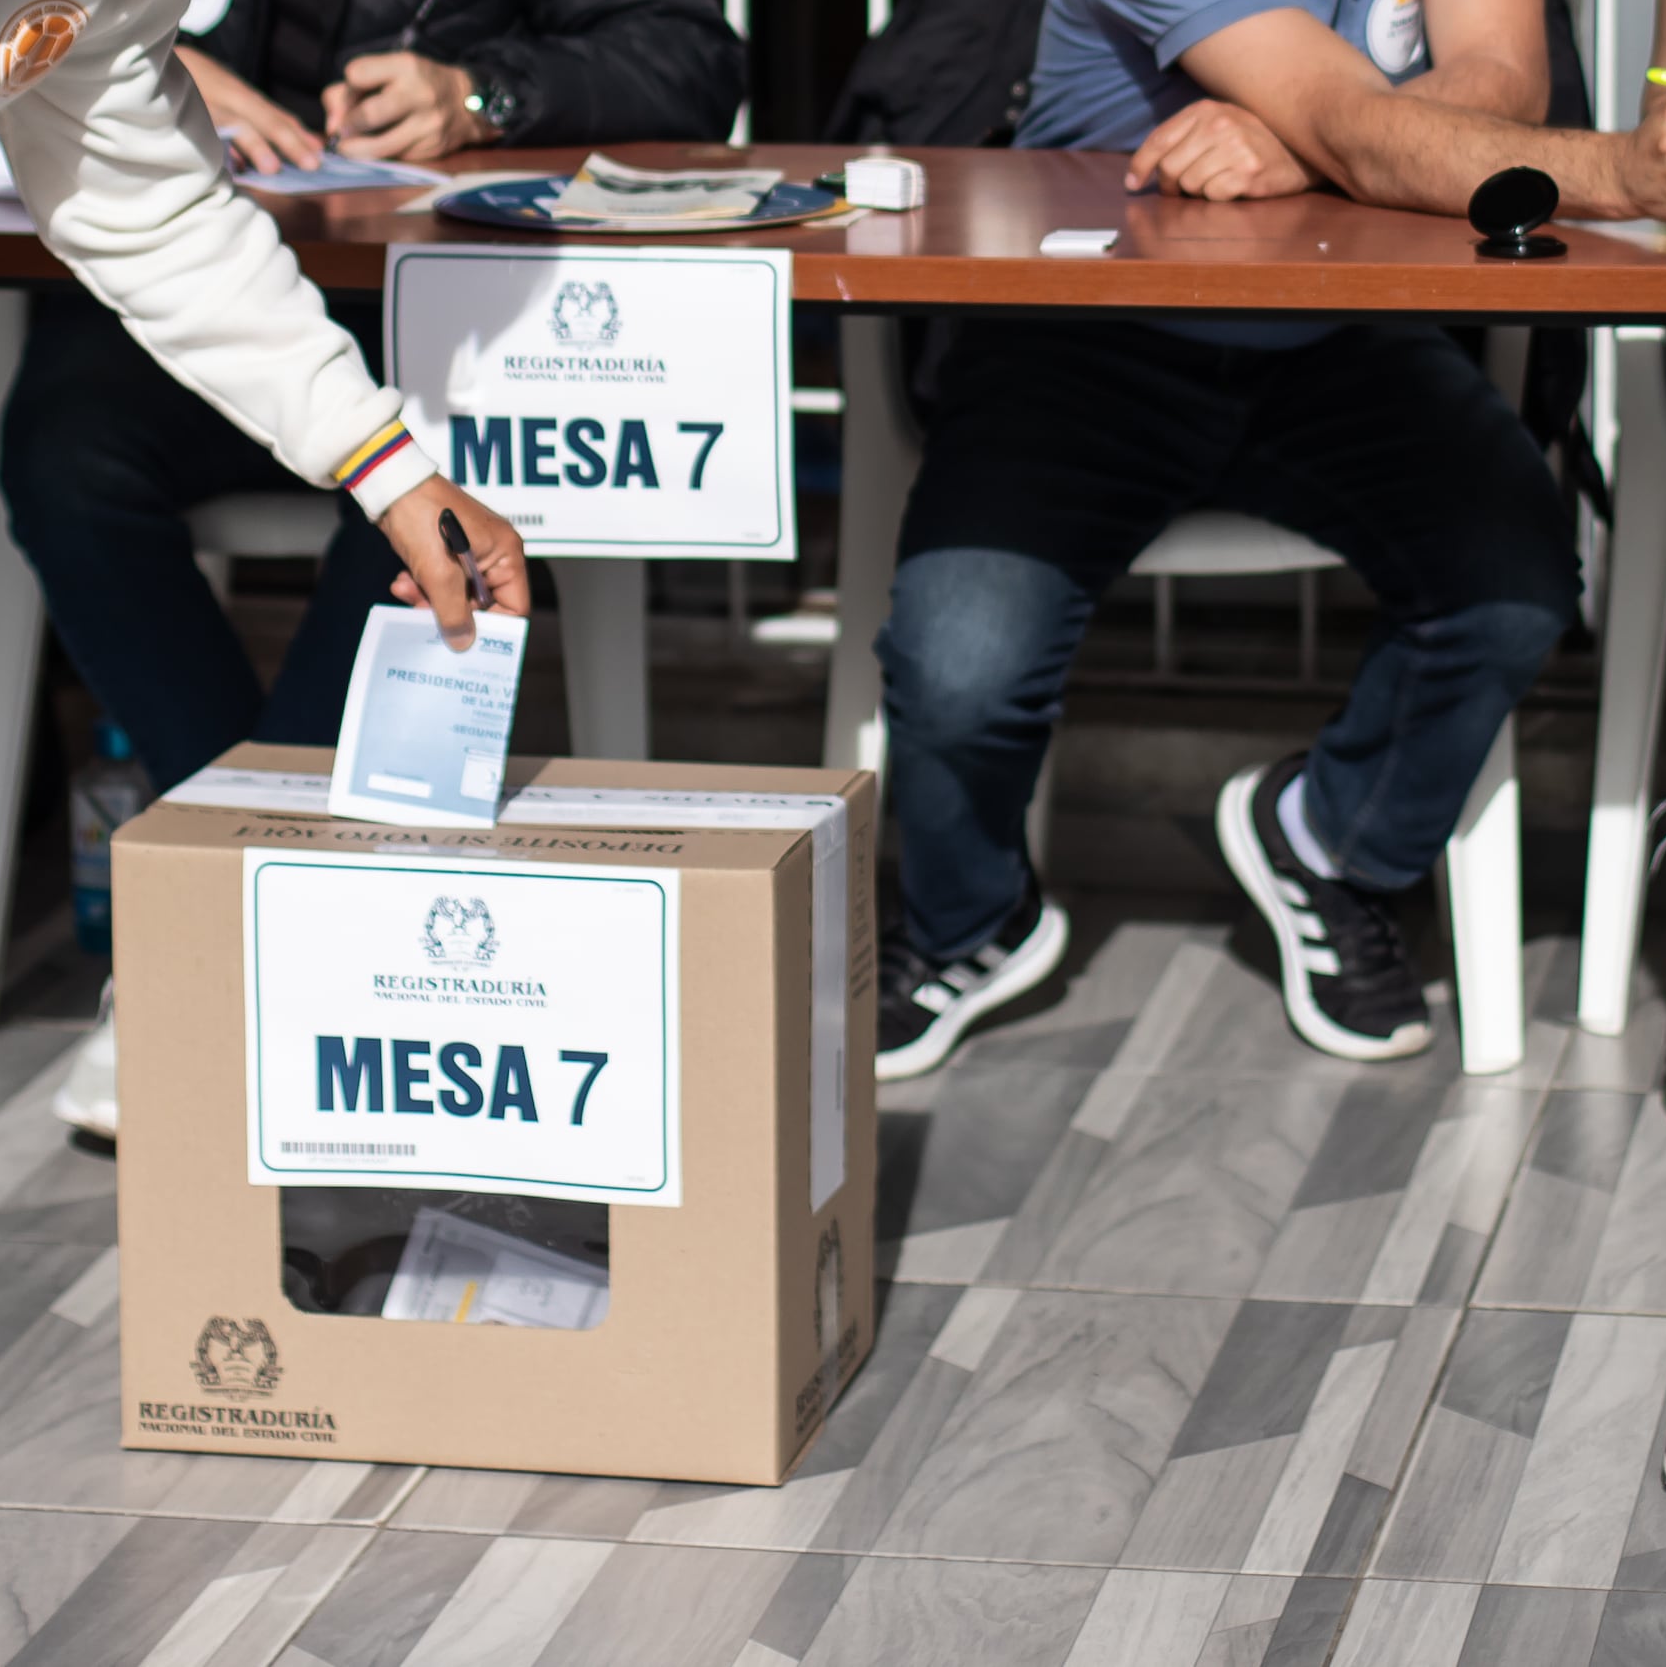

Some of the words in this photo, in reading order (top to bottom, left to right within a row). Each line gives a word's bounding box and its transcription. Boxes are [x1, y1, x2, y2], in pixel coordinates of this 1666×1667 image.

[503, 353, 667, 373] REGISTRADURÍA
[448, 414, 660, 490] MESA
[676, 421, 725, 491] 7
[386, 667, 490, 696] PRESIDENCIA
[334, 830, 433, 844] VOTO
[499, 835, 685, 855] DEPOSITE
[372, 973, 548, 997] REGISTRADURÍA
[373, 990, 433, 1003] NACIONAL
[437, 994, 461, 1005] DEL
[465, 995, 512, 1007] ESTADO
[516, 997, 549, 1009] CIVIL
[314, 1034, 539, 1123] MESA
[558, 1048, 609, 1127] 7
[138, 1401, 338, 1431] REGISTRADURÍA
[138, 1421, 205, 1436] NACIONAL
[211, 1425, 239, 1438] DEL
[242, 1427, 297, 1442] ESTADO
[299, 1431, 337, 1444] CIVIL
